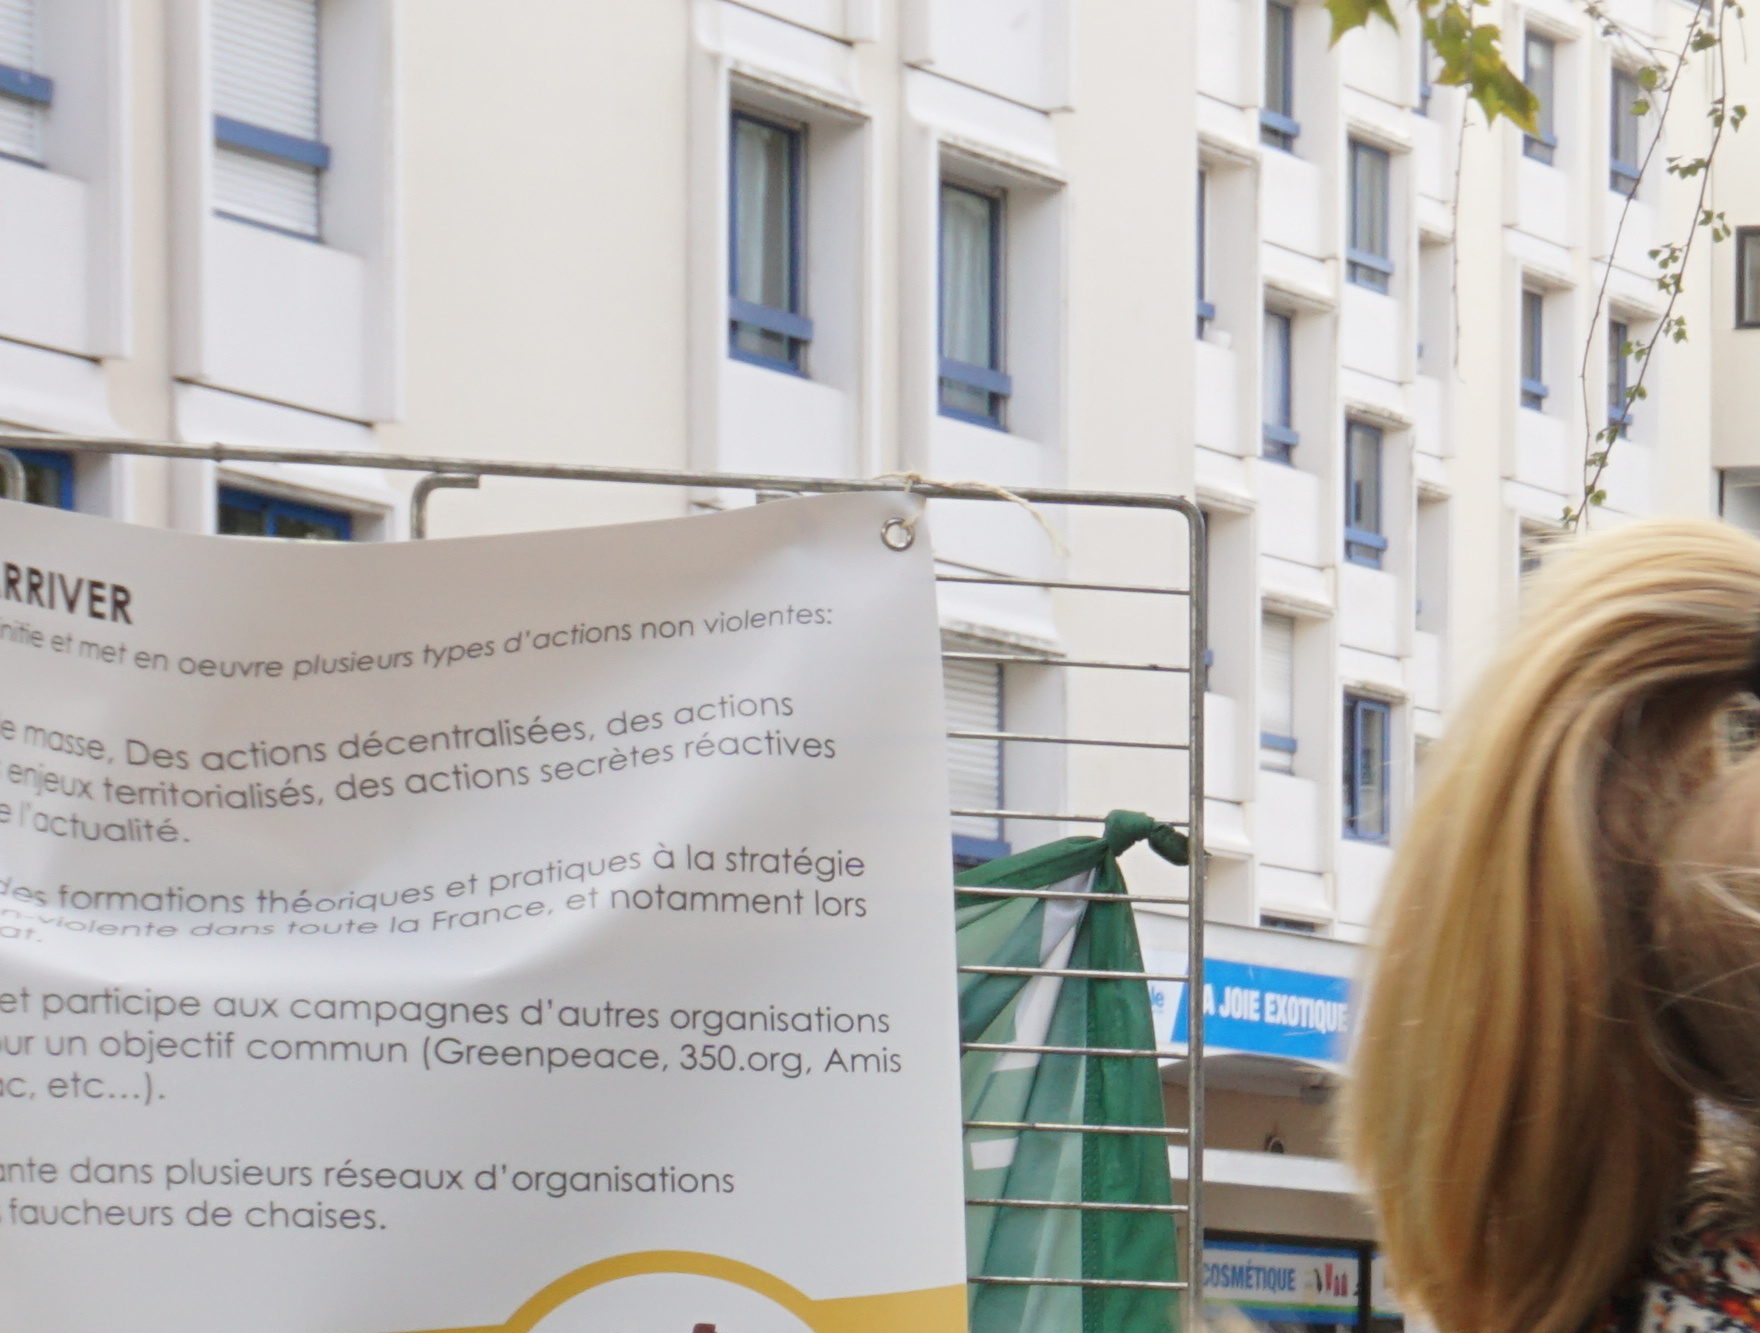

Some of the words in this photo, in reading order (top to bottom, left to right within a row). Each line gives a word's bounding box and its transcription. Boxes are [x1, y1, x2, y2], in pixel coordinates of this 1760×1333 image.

[0, 561, 133, 625] RRIVER
[51, 631, 74, 653] et
[79, 640, 126, 666] met
[135, 650, 169, 674] en
[178, 655, 284, 680] oeuvre
[292, 648, 414, 681] plusieurs
[422, 638, 496, 669] types
[640, 615, 695, 641] non
[126, 738, 190, 772] Des
[202, 740, 328, 773] actions
[337, 714, 596, 762] décentralisées,
[606, 710, 664, 738] des
[674, 694, 794, 727] actions
[7, 763, 95, 801] enjeux
[335, 769, 394, 803] des
[404, 762, 530, 797] actions
[540, 741, 675, 784] secrètes
[684, 728, 837, 760] réactives
[59, 883, 245, 915] formations
[257, 882, 436, 916] théoriques
[446, 873, 477, 899] et
[489, 847, 642, 897] pratiques
[653, 841, 676, 872] à
[687, 843, 715, 872] la
[725, 845, 867, 884] stratégie
[190, 919, 276, 940] dans
[287, 916, 379, 938] toute
[390, 914, 420, 935] la
[432, 899, 554, 933] France,
[566, 886, 599, 912] et
[611, 885, 803, 916] notamment
[814, 889, 867, 918] lors
[42, 988, 201, 1021] participe
[213, 996, 279, 1019] aux
[290, 998, 509, 1030] campagnes
[520, 998, 659, 1030] d'autres
[670, 1004, 890, 1037] organisations
[1219, 985, 1260, 1022] JOIE
[1264, 991, 1349, 1035] EXOTIQUE
[46, 1034, 88, 1058] un
[100, 1029, 236, 1064] objectif
[246, 1036, 408, 1064] commun
[422, 1035, 669, 1074] (Greenpeace,
[680, 1042, 813, 1080] 350.org,
[824, 1046, 903, 1074] Amis
[70, 1156, 154, 1188] dans
[165, 1157, 313, 1191] plusieurs
[324, 1158, 464, 1191] réseaux
[474, 1163, 736, 1199] d'organisations
[8, 1197, 174, 1229] faucheurs
[186, 1199, 234, 1230] de
[245, 1200, 387, 1231] chaises.
[1203, 1259, 1297, 1293] COSMÉTIQUE
